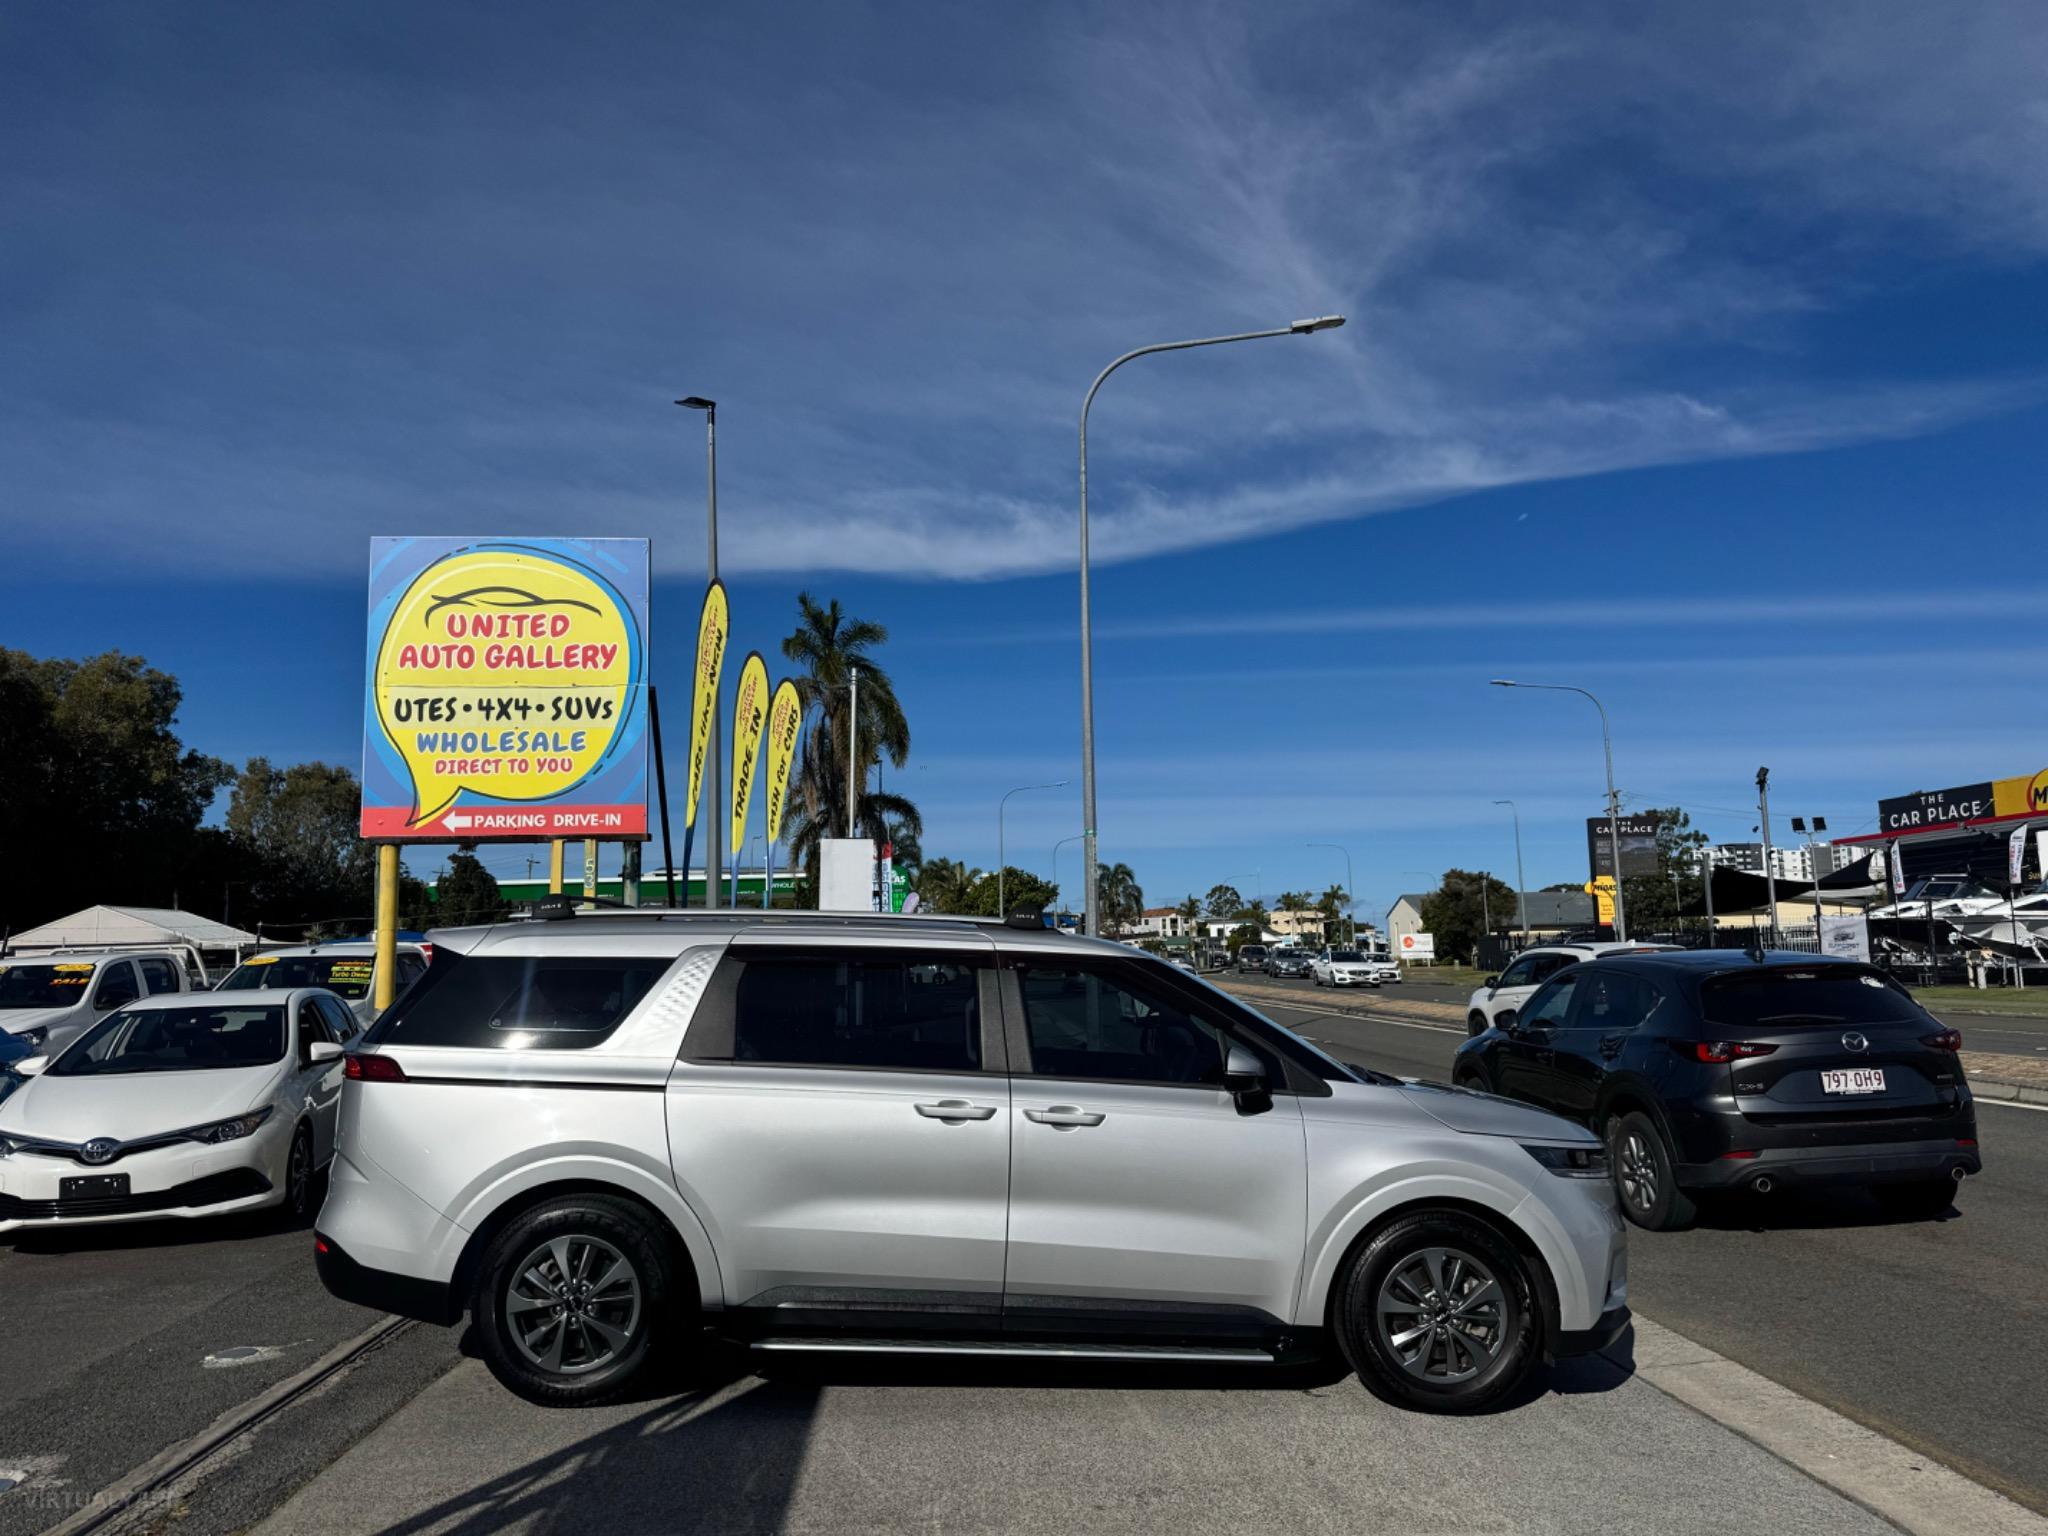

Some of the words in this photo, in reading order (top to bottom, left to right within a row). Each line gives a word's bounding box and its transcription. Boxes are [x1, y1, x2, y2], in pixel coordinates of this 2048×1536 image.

[447, 613, 569, 638] UNITED
[399, 644, 476, 669] AUTO
[484, 643, 618, 670] GALLERY
[394, 697, 457, 722] UTES
[551, 696, 613, 721] SUVs
[784, 704, 798, 751] CARS
[416, 730, 586, 753] WHOLESALE
[435, 758, 502, 774] DIRECT
[507, 758, 529, 773] TO
[536, 757, 573, 773] YOU
[1920, 793, 1945, 805] THE
[474, 814, 546, 828] PARKING
[553, 813, 621, 828] DRIVE-IN
[1889, 811, 1921, 828] CAR
[1927, 800, 1982, 822] PLACE
[1620, 825, 1653, 833] PLACE
